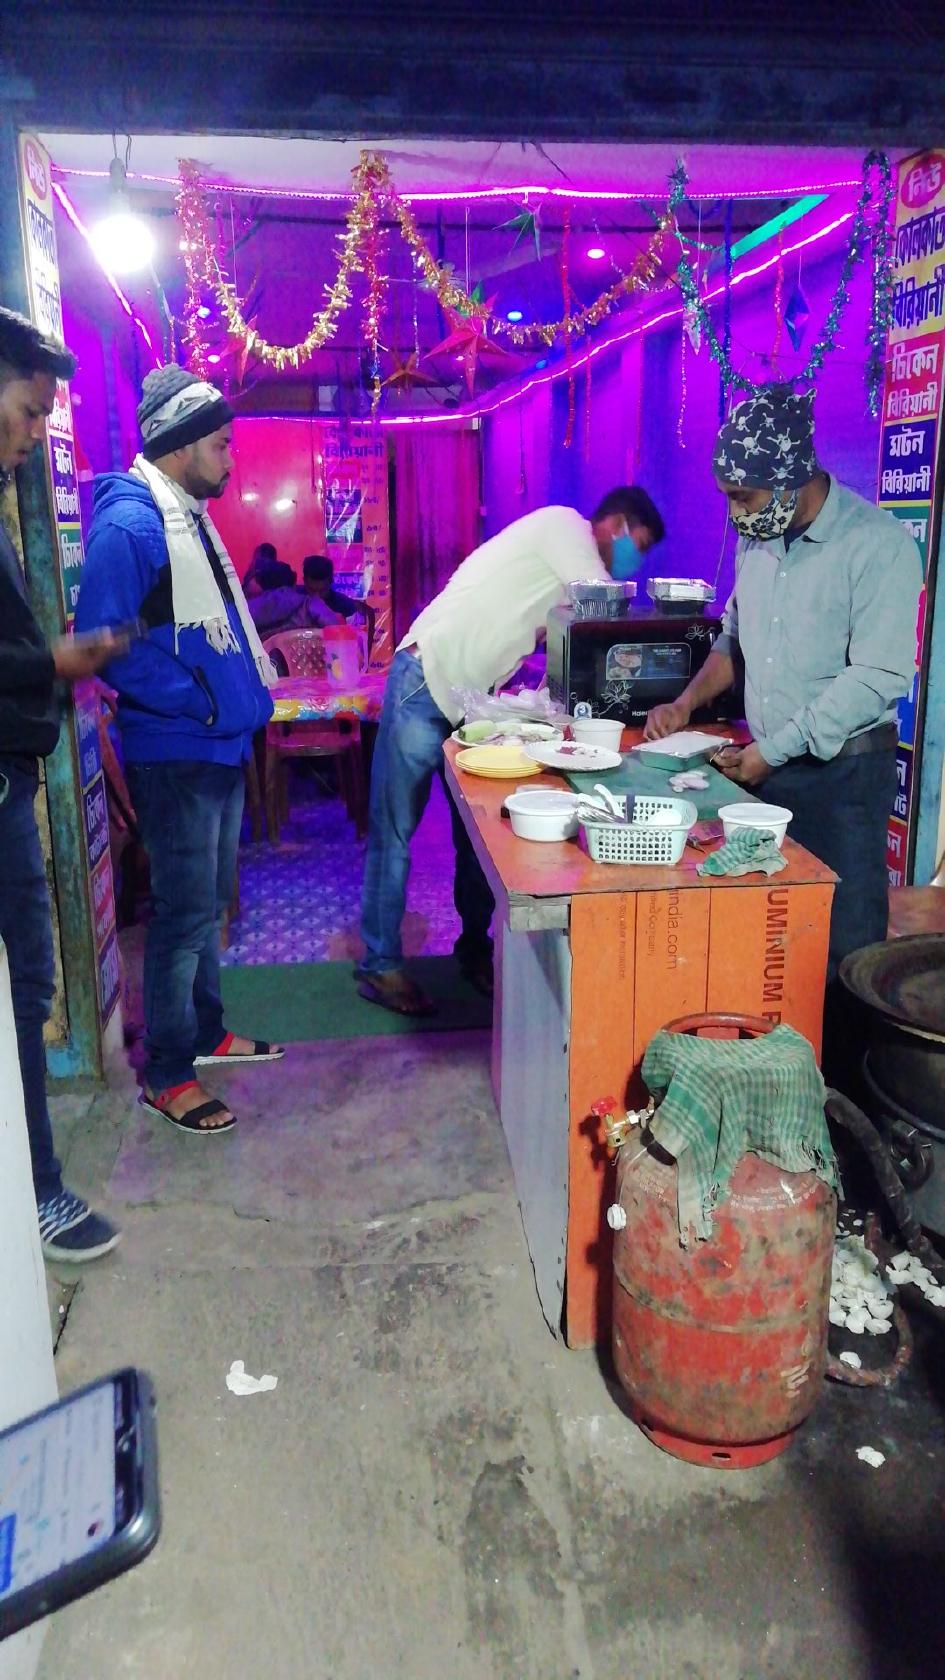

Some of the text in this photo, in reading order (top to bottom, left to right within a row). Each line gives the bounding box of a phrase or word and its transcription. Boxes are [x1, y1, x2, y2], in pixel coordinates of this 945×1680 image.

[908, 162, 942, 202] নিউ
[894, 206, 945, 268] কোলকাত
[892, 342, 939, 383] চিকেন
[887, 381, 938, 418] বিরিয়ানী
[889, 425, 926, 457] মটন
[881, 465, 931, 495] বিরিয়ানী
[666, 889, 683, 969] india.com
